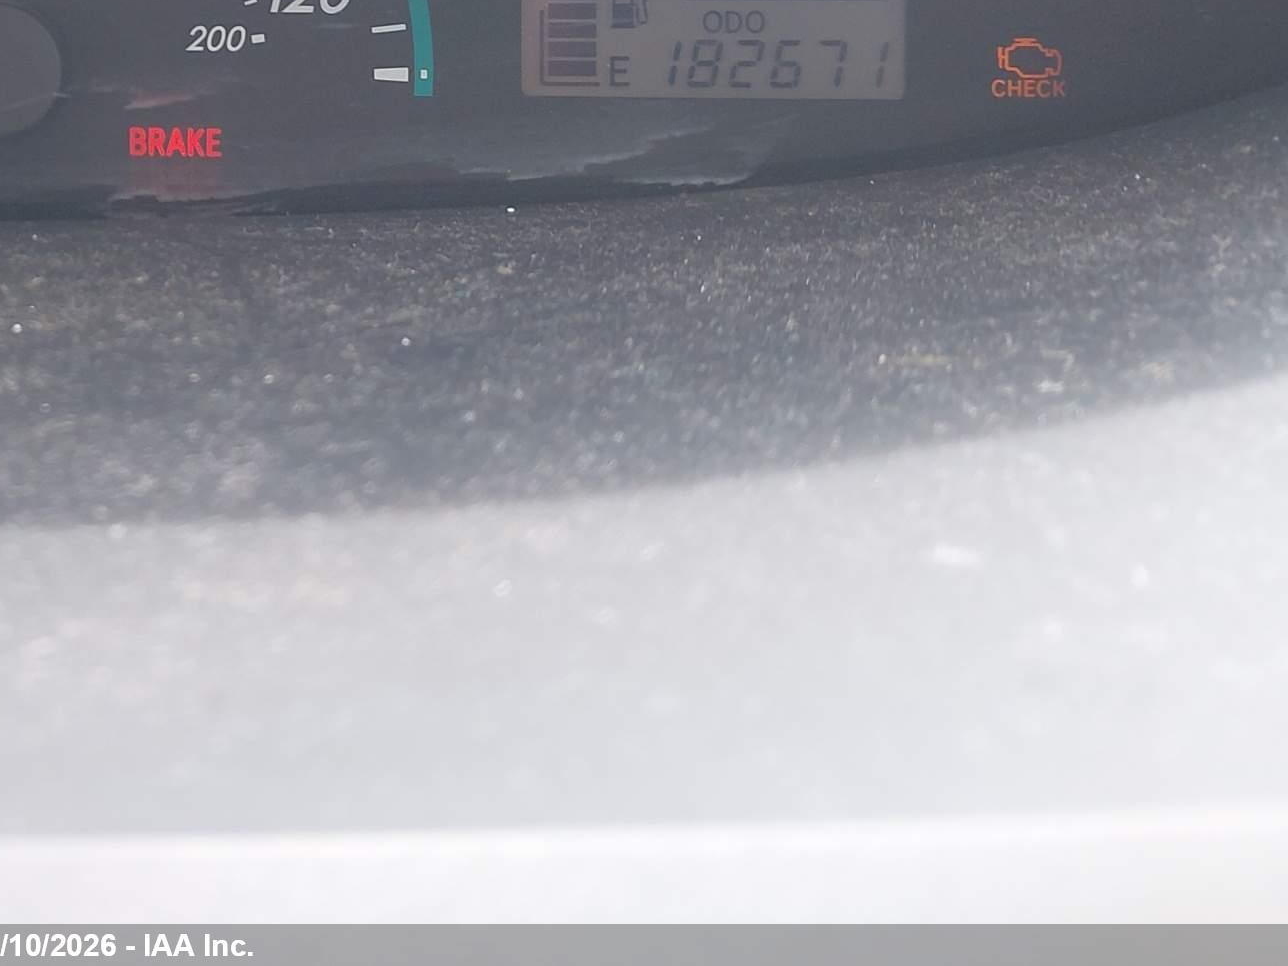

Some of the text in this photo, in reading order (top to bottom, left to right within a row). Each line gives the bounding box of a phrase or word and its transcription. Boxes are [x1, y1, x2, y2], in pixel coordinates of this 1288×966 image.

[702, 10, 766, 34] ODO
[186, 26, 246, 52] 200
[609, 56, 630, 86] E
[666, 40, 890, 87] 182671
[991, 78, 1066, 99] CHECK
[129, 127, 223, 158] BRAKE
